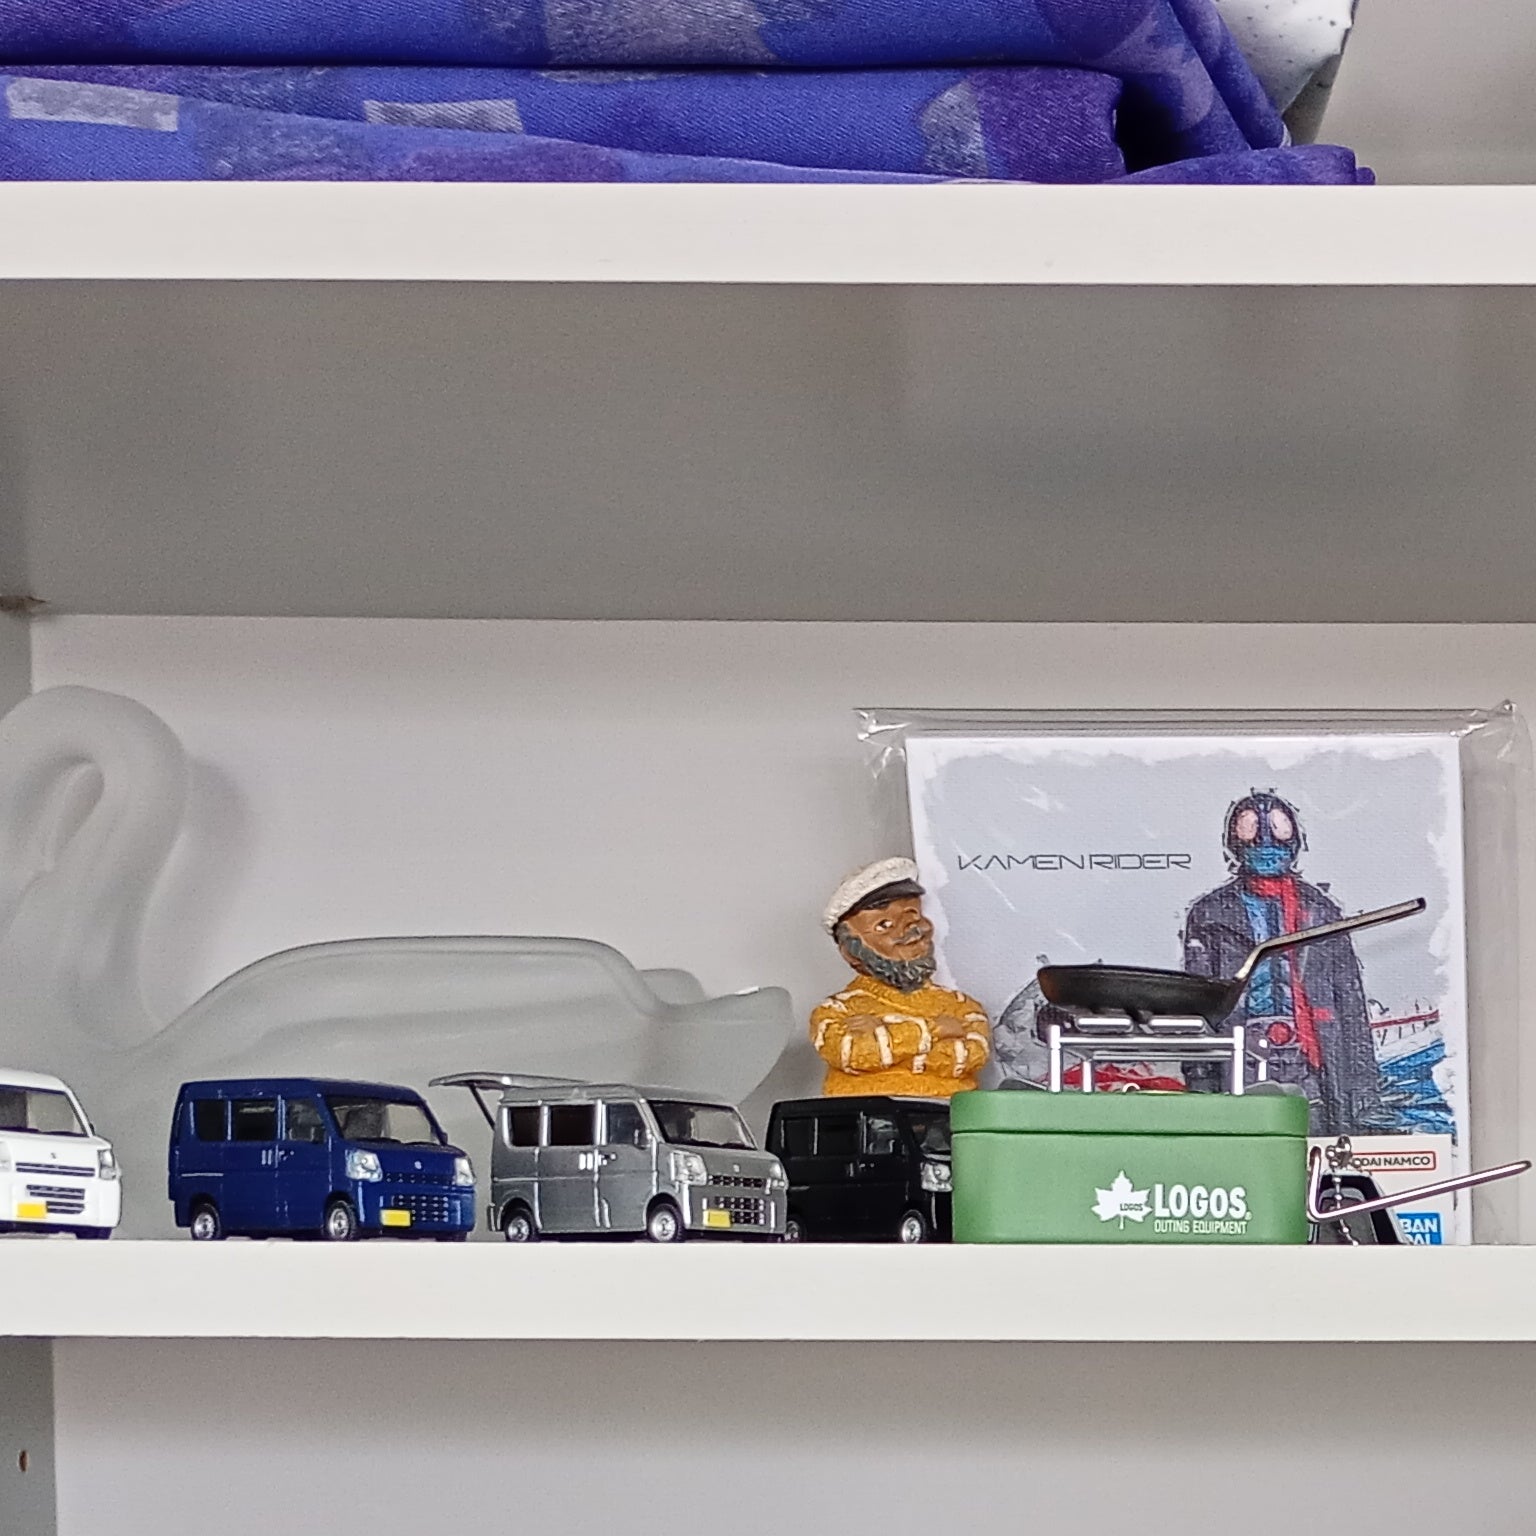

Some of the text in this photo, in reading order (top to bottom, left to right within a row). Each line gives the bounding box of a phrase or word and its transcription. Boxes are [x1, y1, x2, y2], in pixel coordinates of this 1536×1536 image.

[958, 853, 1191, 870] KAMEN RIDER
[1383, 1156, 1431, 1167] NAMCO
[1154, 1183, 1247, 1220] LOGOS
[1154, 1219, 1248, 1234] OUTING EQUIPMENT
